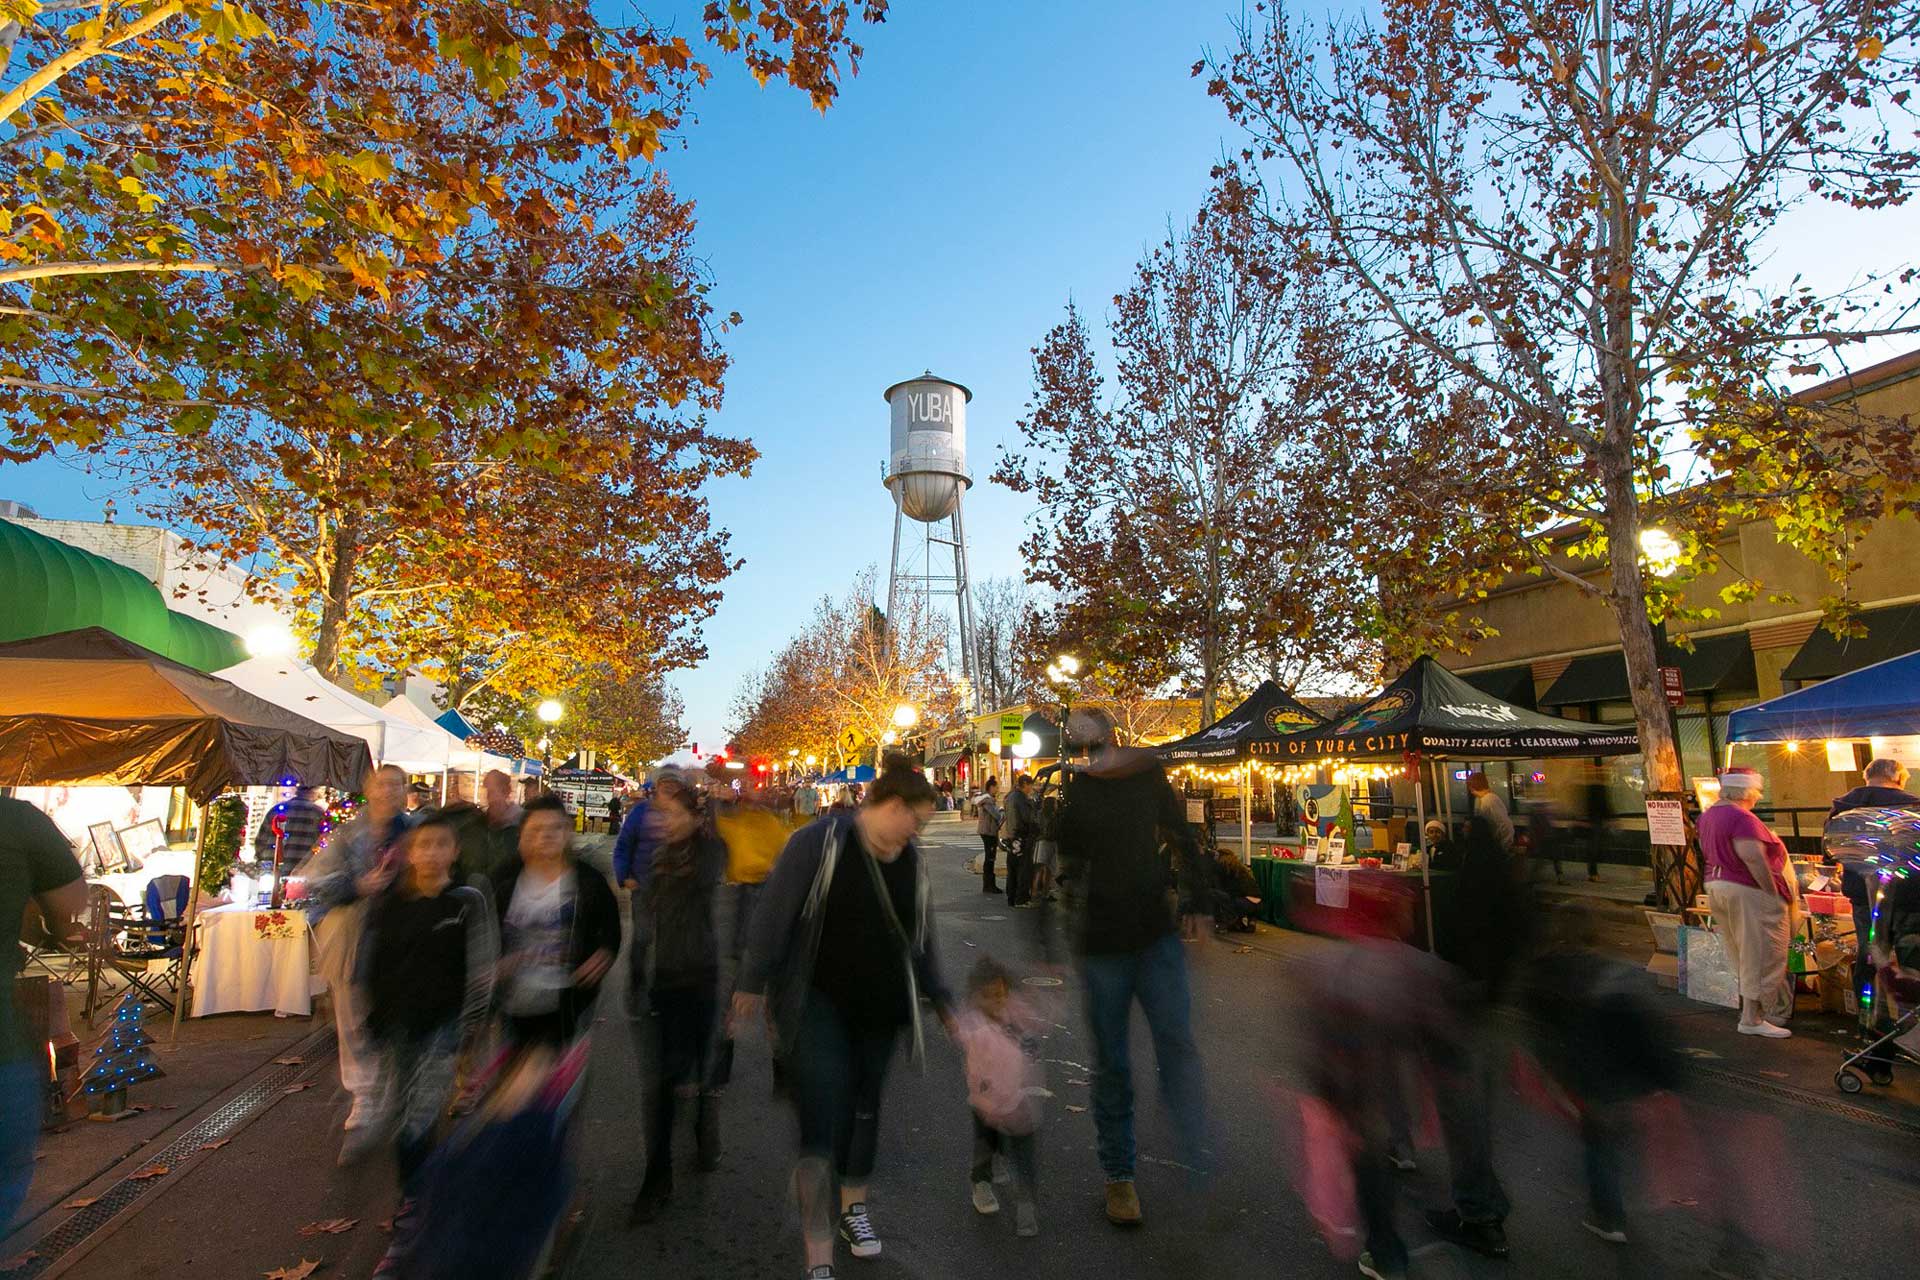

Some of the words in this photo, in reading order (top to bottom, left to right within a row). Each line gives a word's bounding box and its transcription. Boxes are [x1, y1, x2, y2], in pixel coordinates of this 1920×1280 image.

[908, 392, 952, 424] YUBA
[1250, 741, 1279, 754] CITY
[1289, 741, 1306, 754] OF
[1315, 739, 1356, 754] YUBA
[1366, 733, 1409, 751] CITY
[1422, 736, 1468, 748] QUALITY
[1470, 737, 1512, 748] SERVICE
[1520, 737, 1580, 748] LEADERSHIP
[1588, 735, 1639, 746] INNOVATIO
[553, 789, 574, 804] REE
[1647, 801, 1656, 809] NO
[1656, 801, 1681, 809] PARKING
